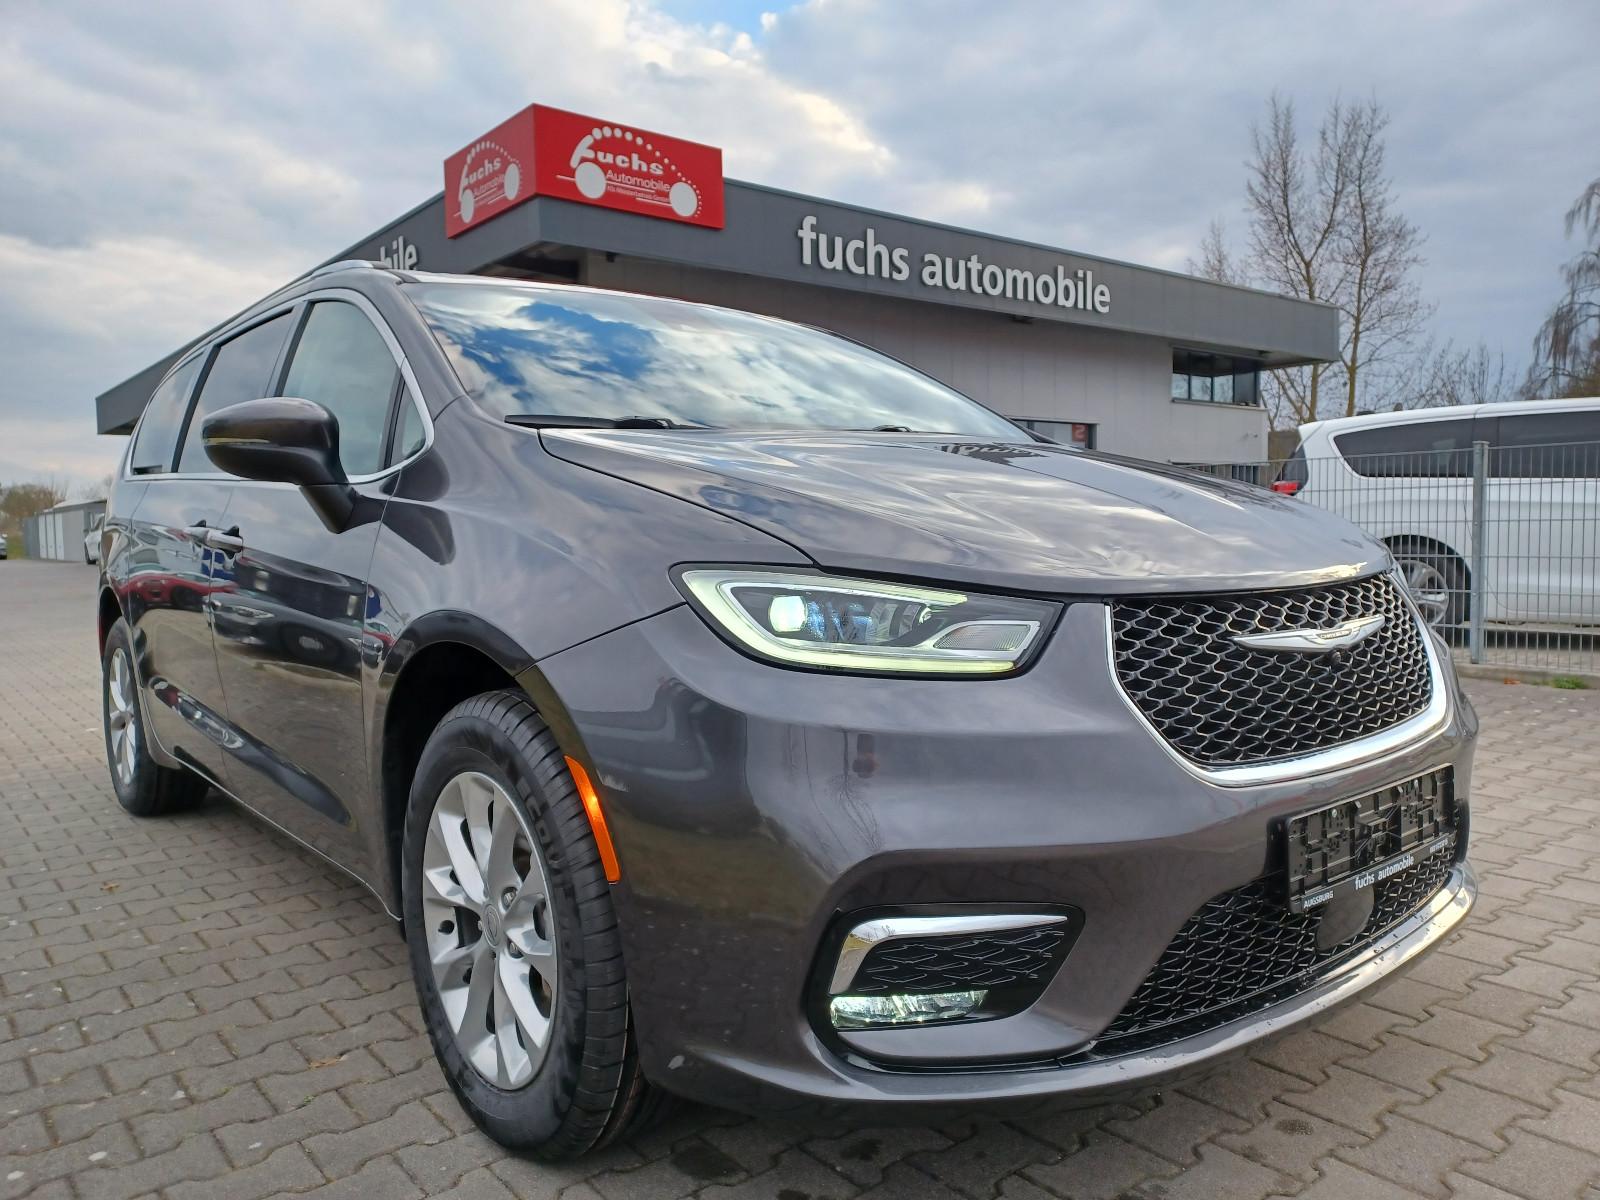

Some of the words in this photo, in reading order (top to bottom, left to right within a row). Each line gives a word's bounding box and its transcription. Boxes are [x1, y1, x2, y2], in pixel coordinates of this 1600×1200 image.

[606, 169, 671, 192] Automobile
[798, 215, 910, 281] fuchs
[921, 252, 1111, 313] automobile
[1354, 873, 1375, 890] fuchs
[1377, 853, 1415, 880] automobile
